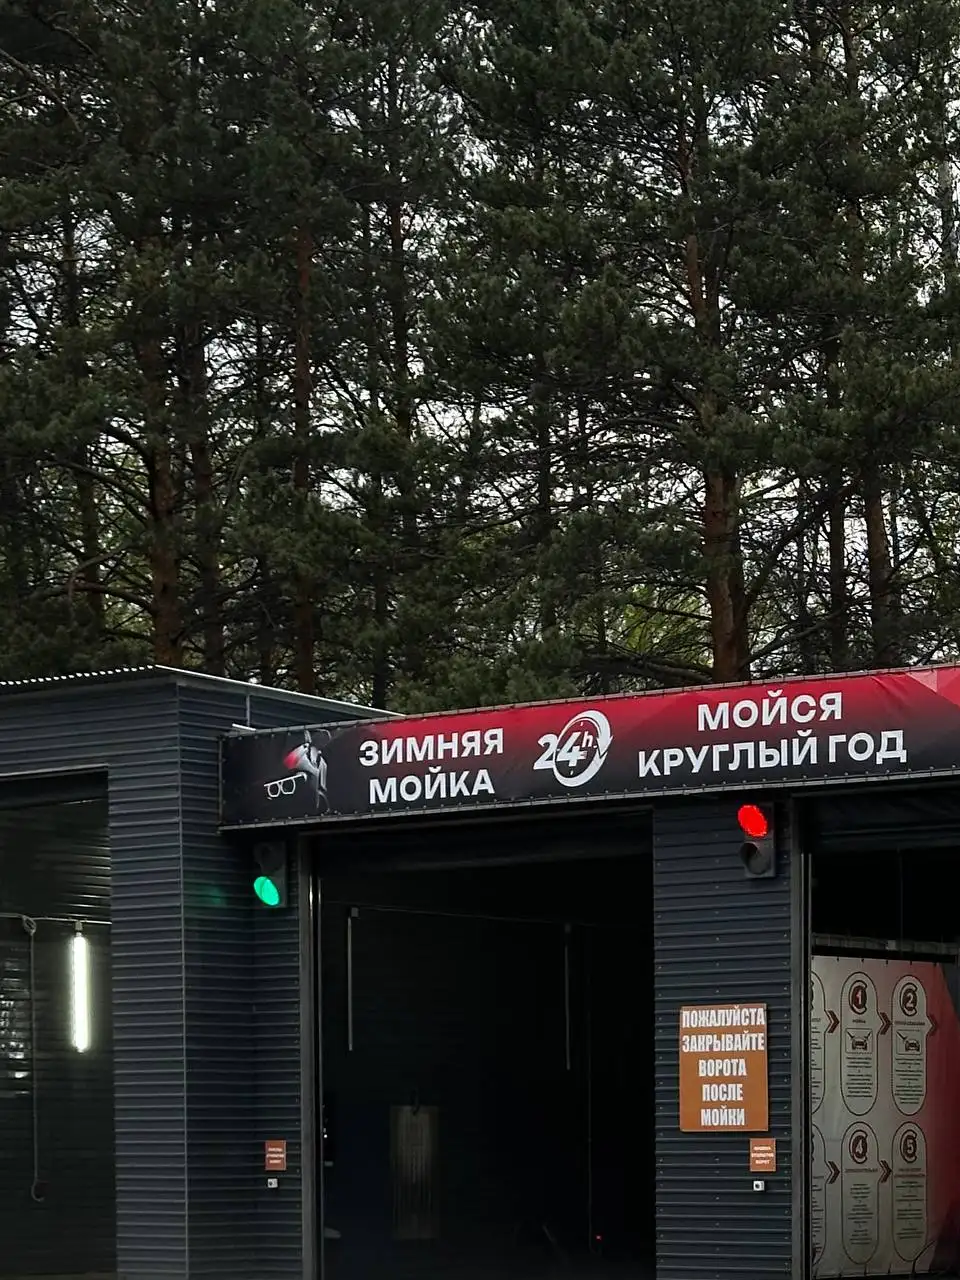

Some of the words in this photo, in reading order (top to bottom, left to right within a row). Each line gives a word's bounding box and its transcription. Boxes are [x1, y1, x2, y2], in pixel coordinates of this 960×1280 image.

[697, 689, 843, 731] МОЙСЯ
[359, 727, 504, 767] ЗИМНЯЯ
[638, 729, 818, 778] КРУГЛЫЙ
[828, 730, 907, 765] ГОД
[369, 765, 496, 804] МОЙКА
[682, 1005, 765, 1028] ПОЖАЛУЙСТА
[682, 1031, 765, 1053] ЗАКРЫВАЙТЕ
[698, 1058, 747, 1077] ВОРОТА
[702, 1083, 744, 1102] ПОСЛЕ
[701, 1106, 745, 1126] МОЙКИ
